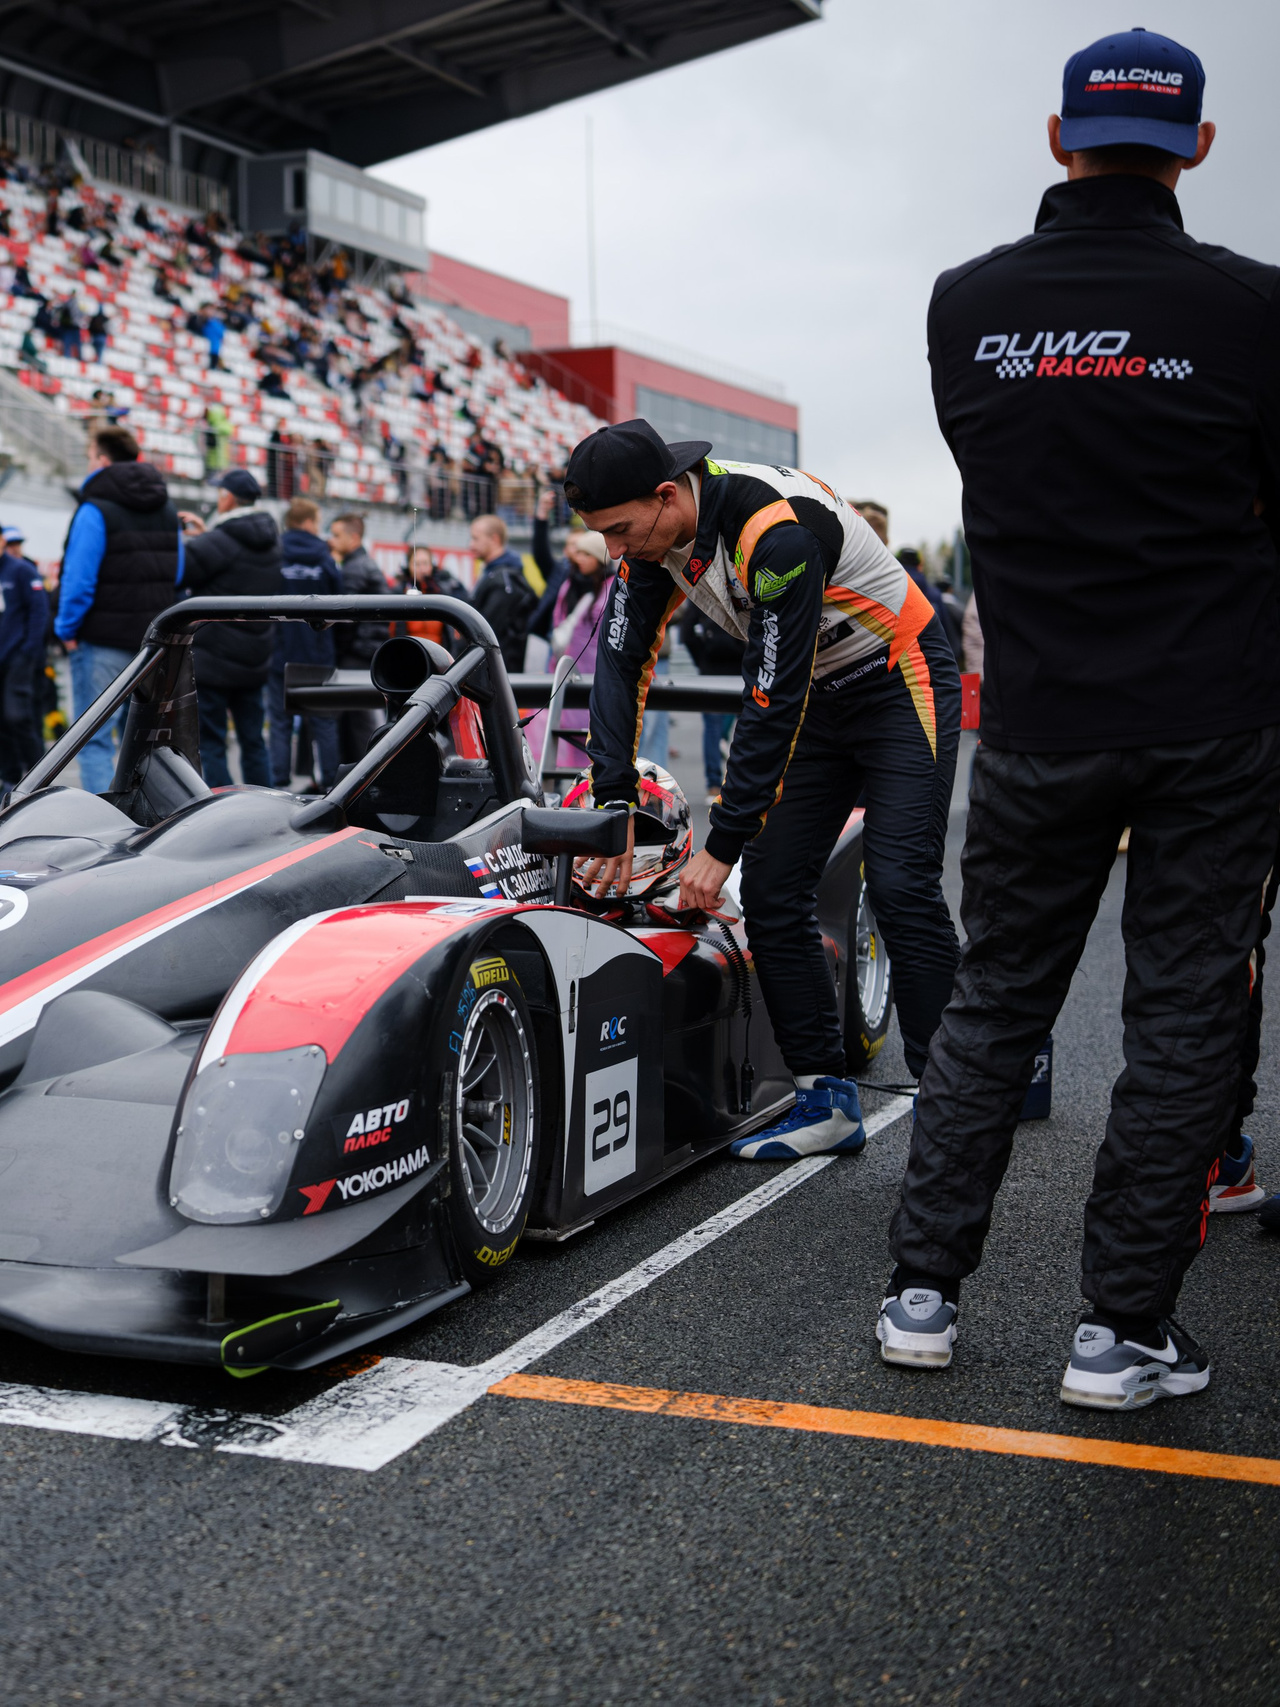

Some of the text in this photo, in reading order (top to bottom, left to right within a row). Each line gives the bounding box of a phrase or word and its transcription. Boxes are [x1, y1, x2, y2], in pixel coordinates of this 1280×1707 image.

[1089, 68, 1183, 86] BALCHUG
[1142, 84, 1179, 94] RACING
[974, 331, 1131, 361] DUWO
[1036, 356, 1147, 377] RACING
[752, 611, 781, 708] G-ENERGY
[470, 957, 510, 989] PIRELLI
[346, 1099, 410, 1137] АВТО
[592, 1090, 630, 1162] 29
[343, 1127, 392, 1154] ПЛЮС
[336, 1145, 430, 1200] YOKOHAMA
[476, 1235, 519, 1267] ZERO
[912, 1293, 930, 1301] NIKE
[1081, 1330, 1099, 1338] NIKE
